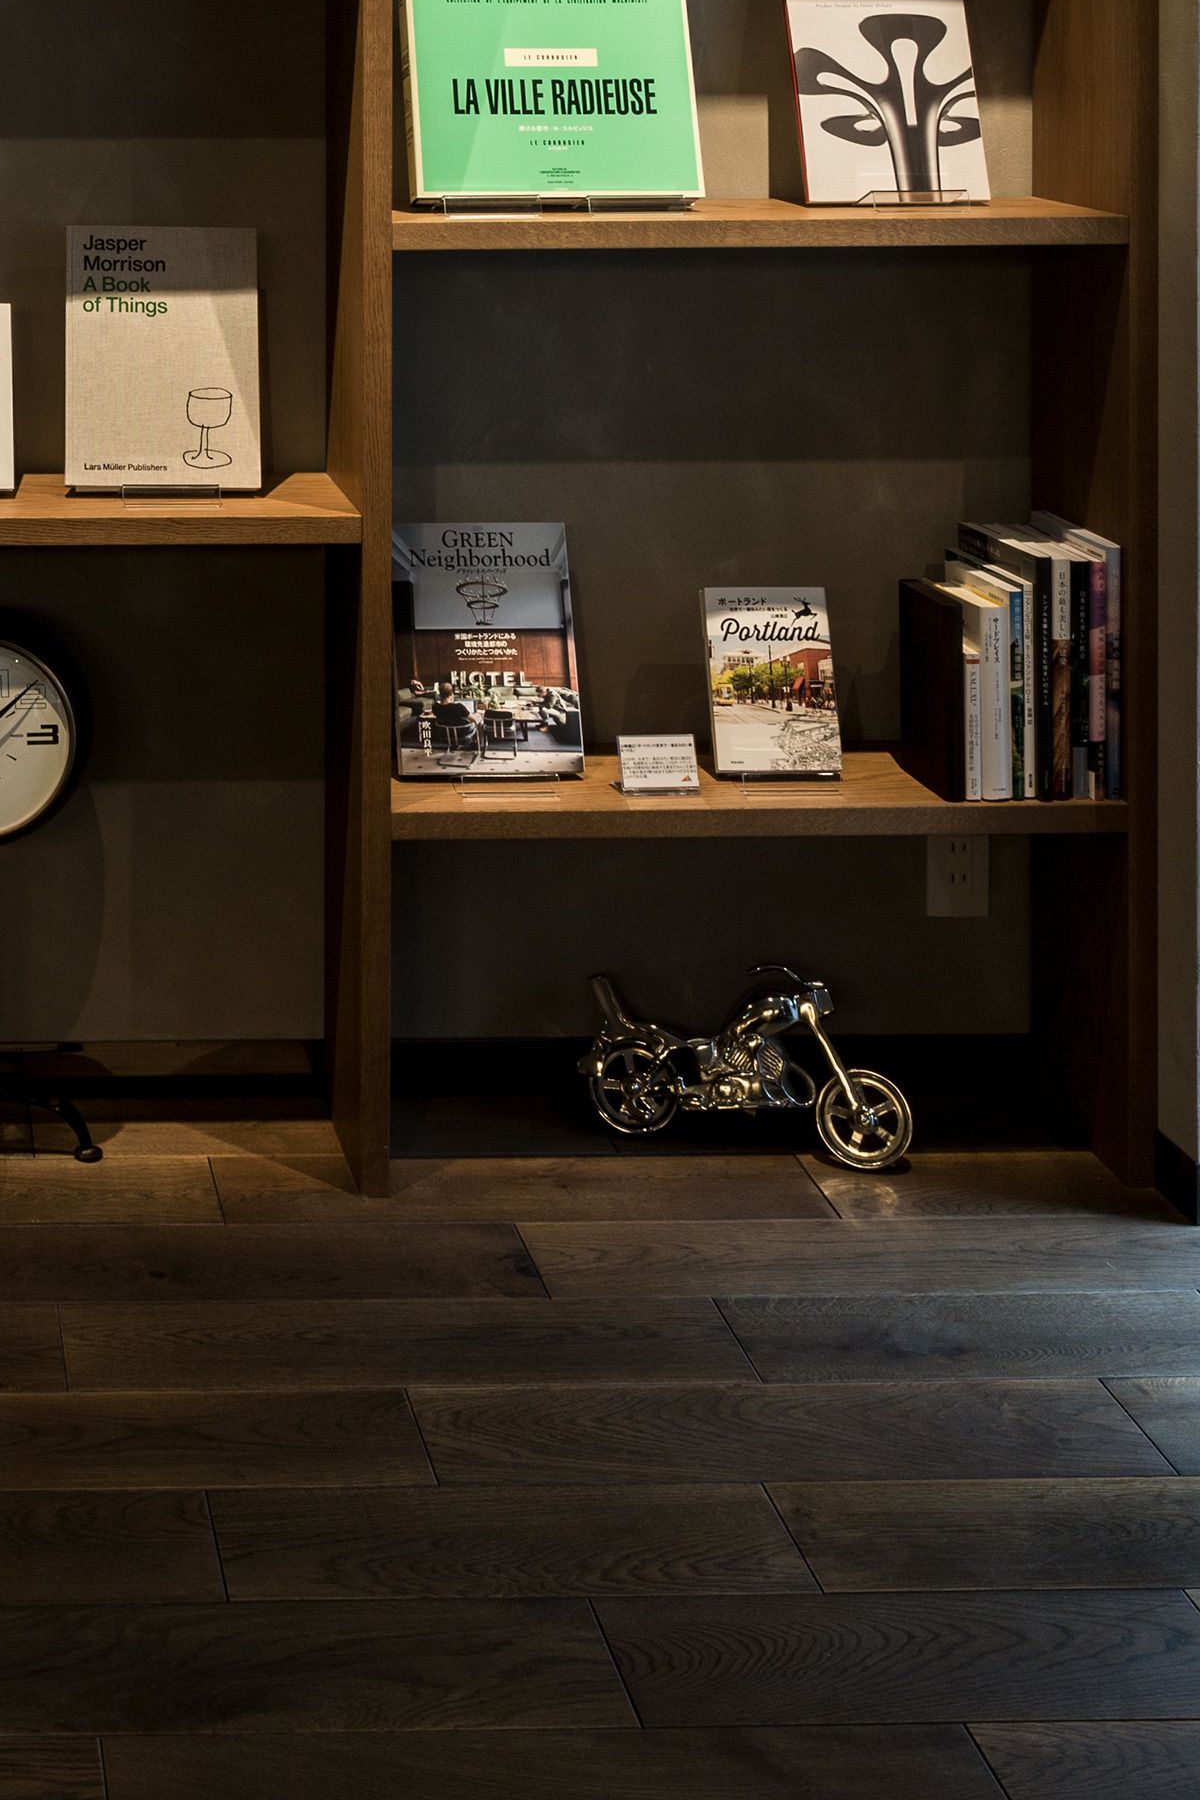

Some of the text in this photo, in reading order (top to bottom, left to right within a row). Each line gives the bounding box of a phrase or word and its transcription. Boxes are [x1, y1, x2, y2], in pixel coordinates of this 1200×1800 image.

[452, 78, 658, 115] LA VILLE RADIEUSE
[83, 235, 147, 254] Jasper
[84, 255, 166, 272] Morrison
[83, 276, 151, 292] A Book
[83, 296, 168, 317] of Things
[84, 463, 167, 471] Lars Müller Publishers
[441, 530, 514, 548] GREEN
[409, 548, 551, 571] Neighborhood
[718, 597, 767, 606] ポートランド
[454, 633, 517, 641] 米国ポートランドにみる
[720, 617, 821, 642] Portland
[455, 648, 518, 656] つくりかたとつかいかた
[450, 671, 533, 687] HOTEL
[27, 724, 59, 746] 3
